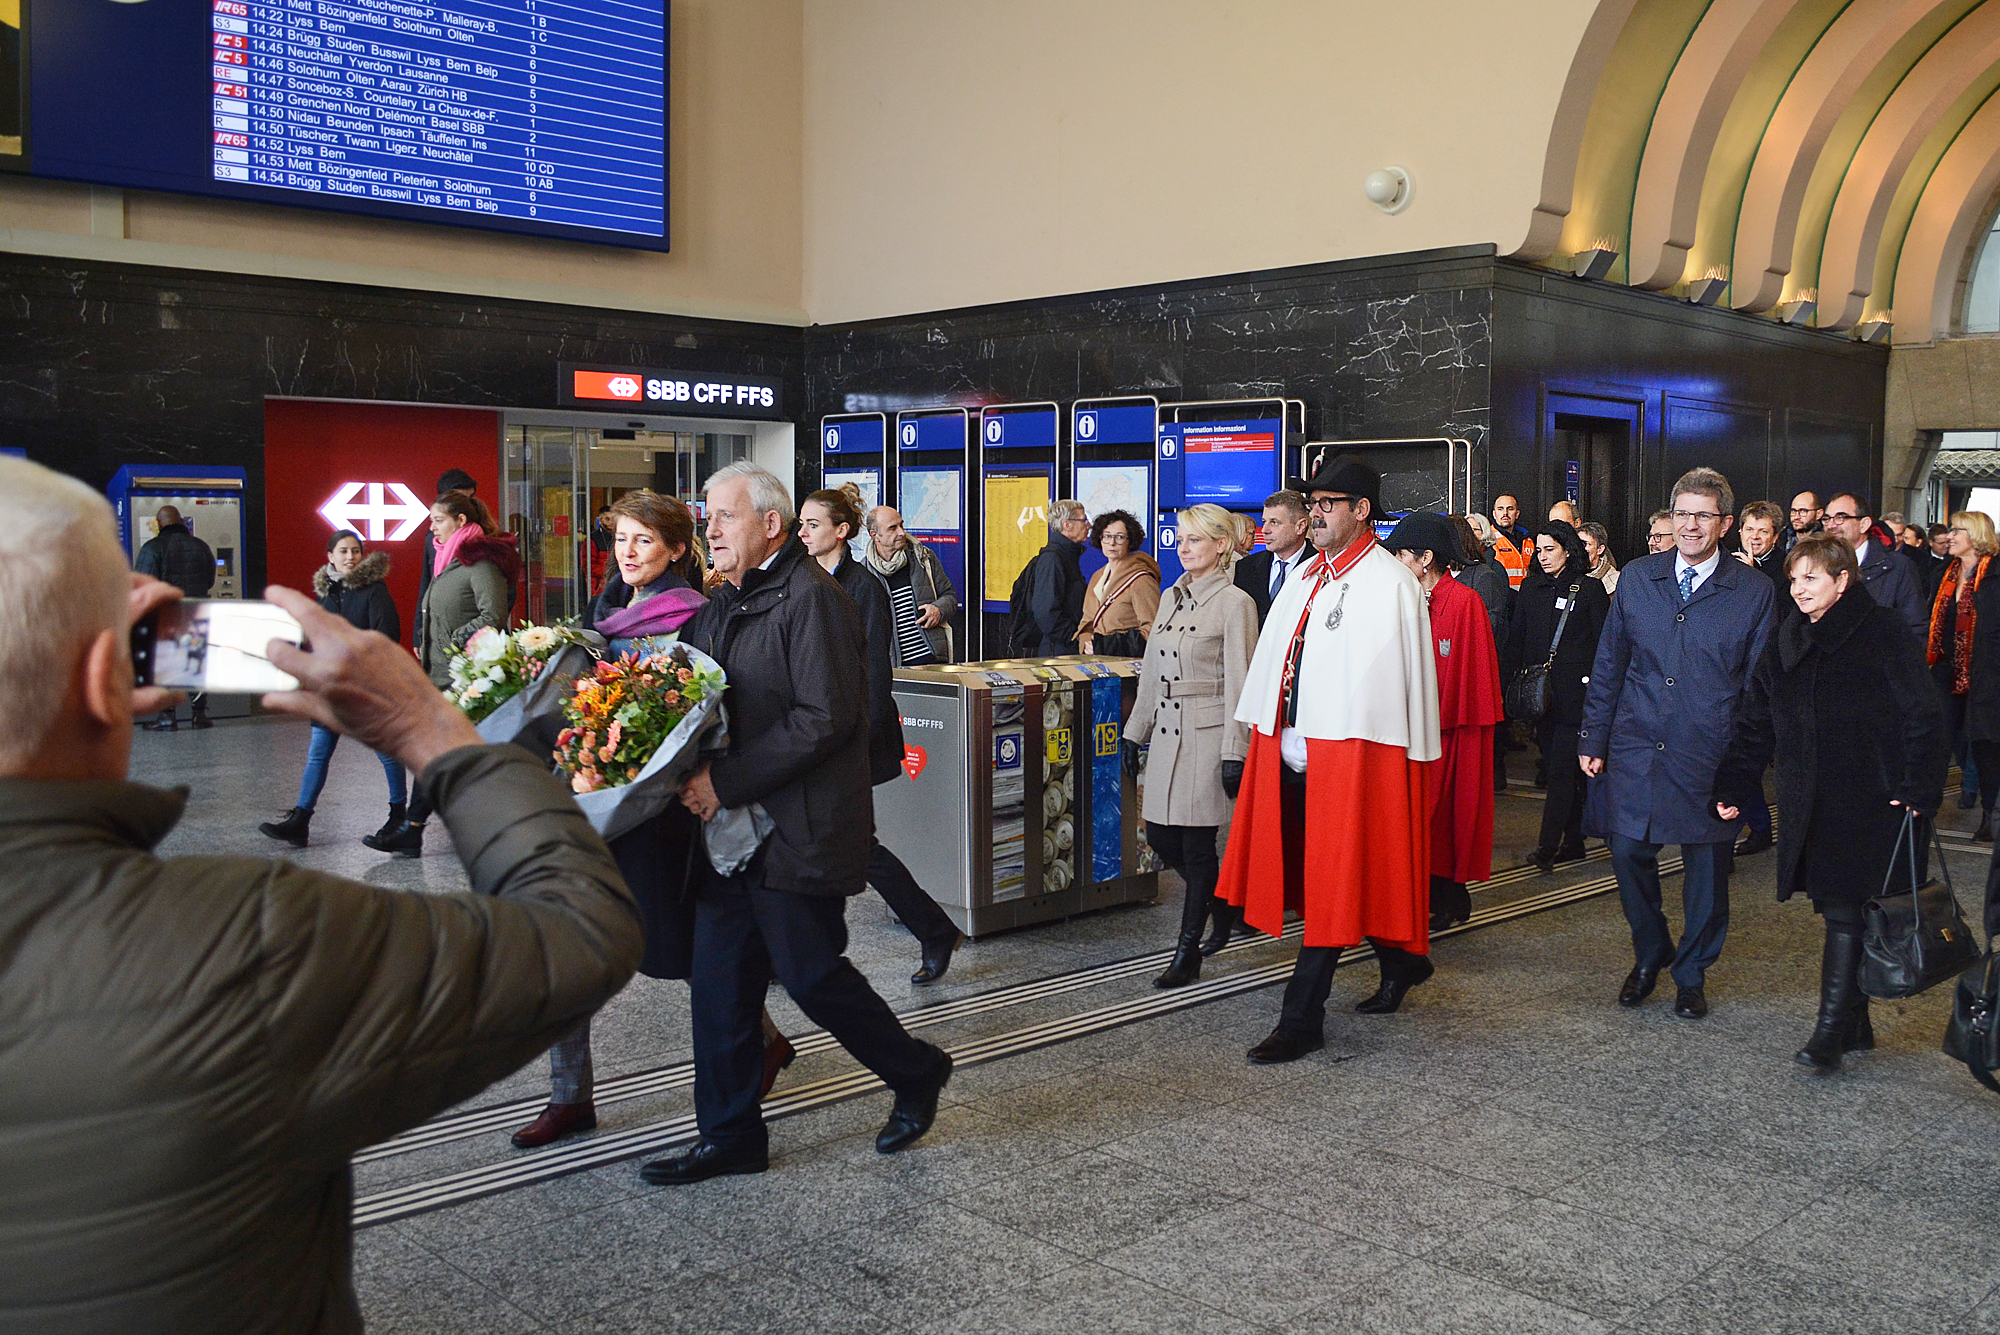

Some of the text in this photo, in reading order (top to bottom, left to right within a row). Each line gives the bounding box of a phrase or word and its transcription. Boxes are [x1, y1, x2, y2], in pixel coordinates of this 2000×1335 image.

[288, 0, 311, 11] Mett
[318, 3, 387, 25] Bözingenfeld
[393, 18, 441, 36] Solothurn
[448, 29, 474, 42] Olten
[530, 45, 536, 54] 3
[444, 13, 498, 32] Malleray-B.
[531, 31, 534, 40] 1
[539, 32, 547, 42] C
[526, 0, 536, 11] 11
[531, 16, 546, 27] 1 B
[215, 18, 536, 84] S3 14.24 Brügg Studen Busswil Lyss Bern Belp 9
[253, 7, 283, 22] 14.22
[288, 13, 314, 28] Lyss
[320, 19, 345, 33] Bern
[530, 60, 536, 69] 6
[215, 34, 536, 98] IC 5 14.45 Neuchâtel Yverdon Lausanne 5
[215, 50, 536, 113] IC 5 14.46 Solothurn Olten Aarau Zürich HB 3
[215, 67, 534, 128] RE 14.47 Sonceboz-S. Courtelary La Chaux-de-F. 1
[215, 83, 536, 142] IC 51 14.49 Grenchen Nord Delémont Basel SBB 2
[216, 100, 534, 157] R 14.50 Nidau Beunden Ipsach Täuffelen Ins 11
[216, 116, 554, 174] R 14.50 Tüscherz Twann Ligerz Neuchâtel 10 CD
[216, 149, 536, 201] R 14.53 Mett Bözingenfeld Pieterlen Solothurn 6
[254, 138, 283, 151] 14.52
[288, 142, 313, 155] Lyss
[320, 146, 345, 159] Bern
[525, 177, 536, 186] 10
[539, 179, 553, 189] AB
[216, 166, 536, 216] S3 14.54 Brügg Studen Busswil Lyss Bern Belp 9
[646, 379, 774, 407] SBB CFF FFS
[903, 717, 944, 729] SBB CFF FFS
